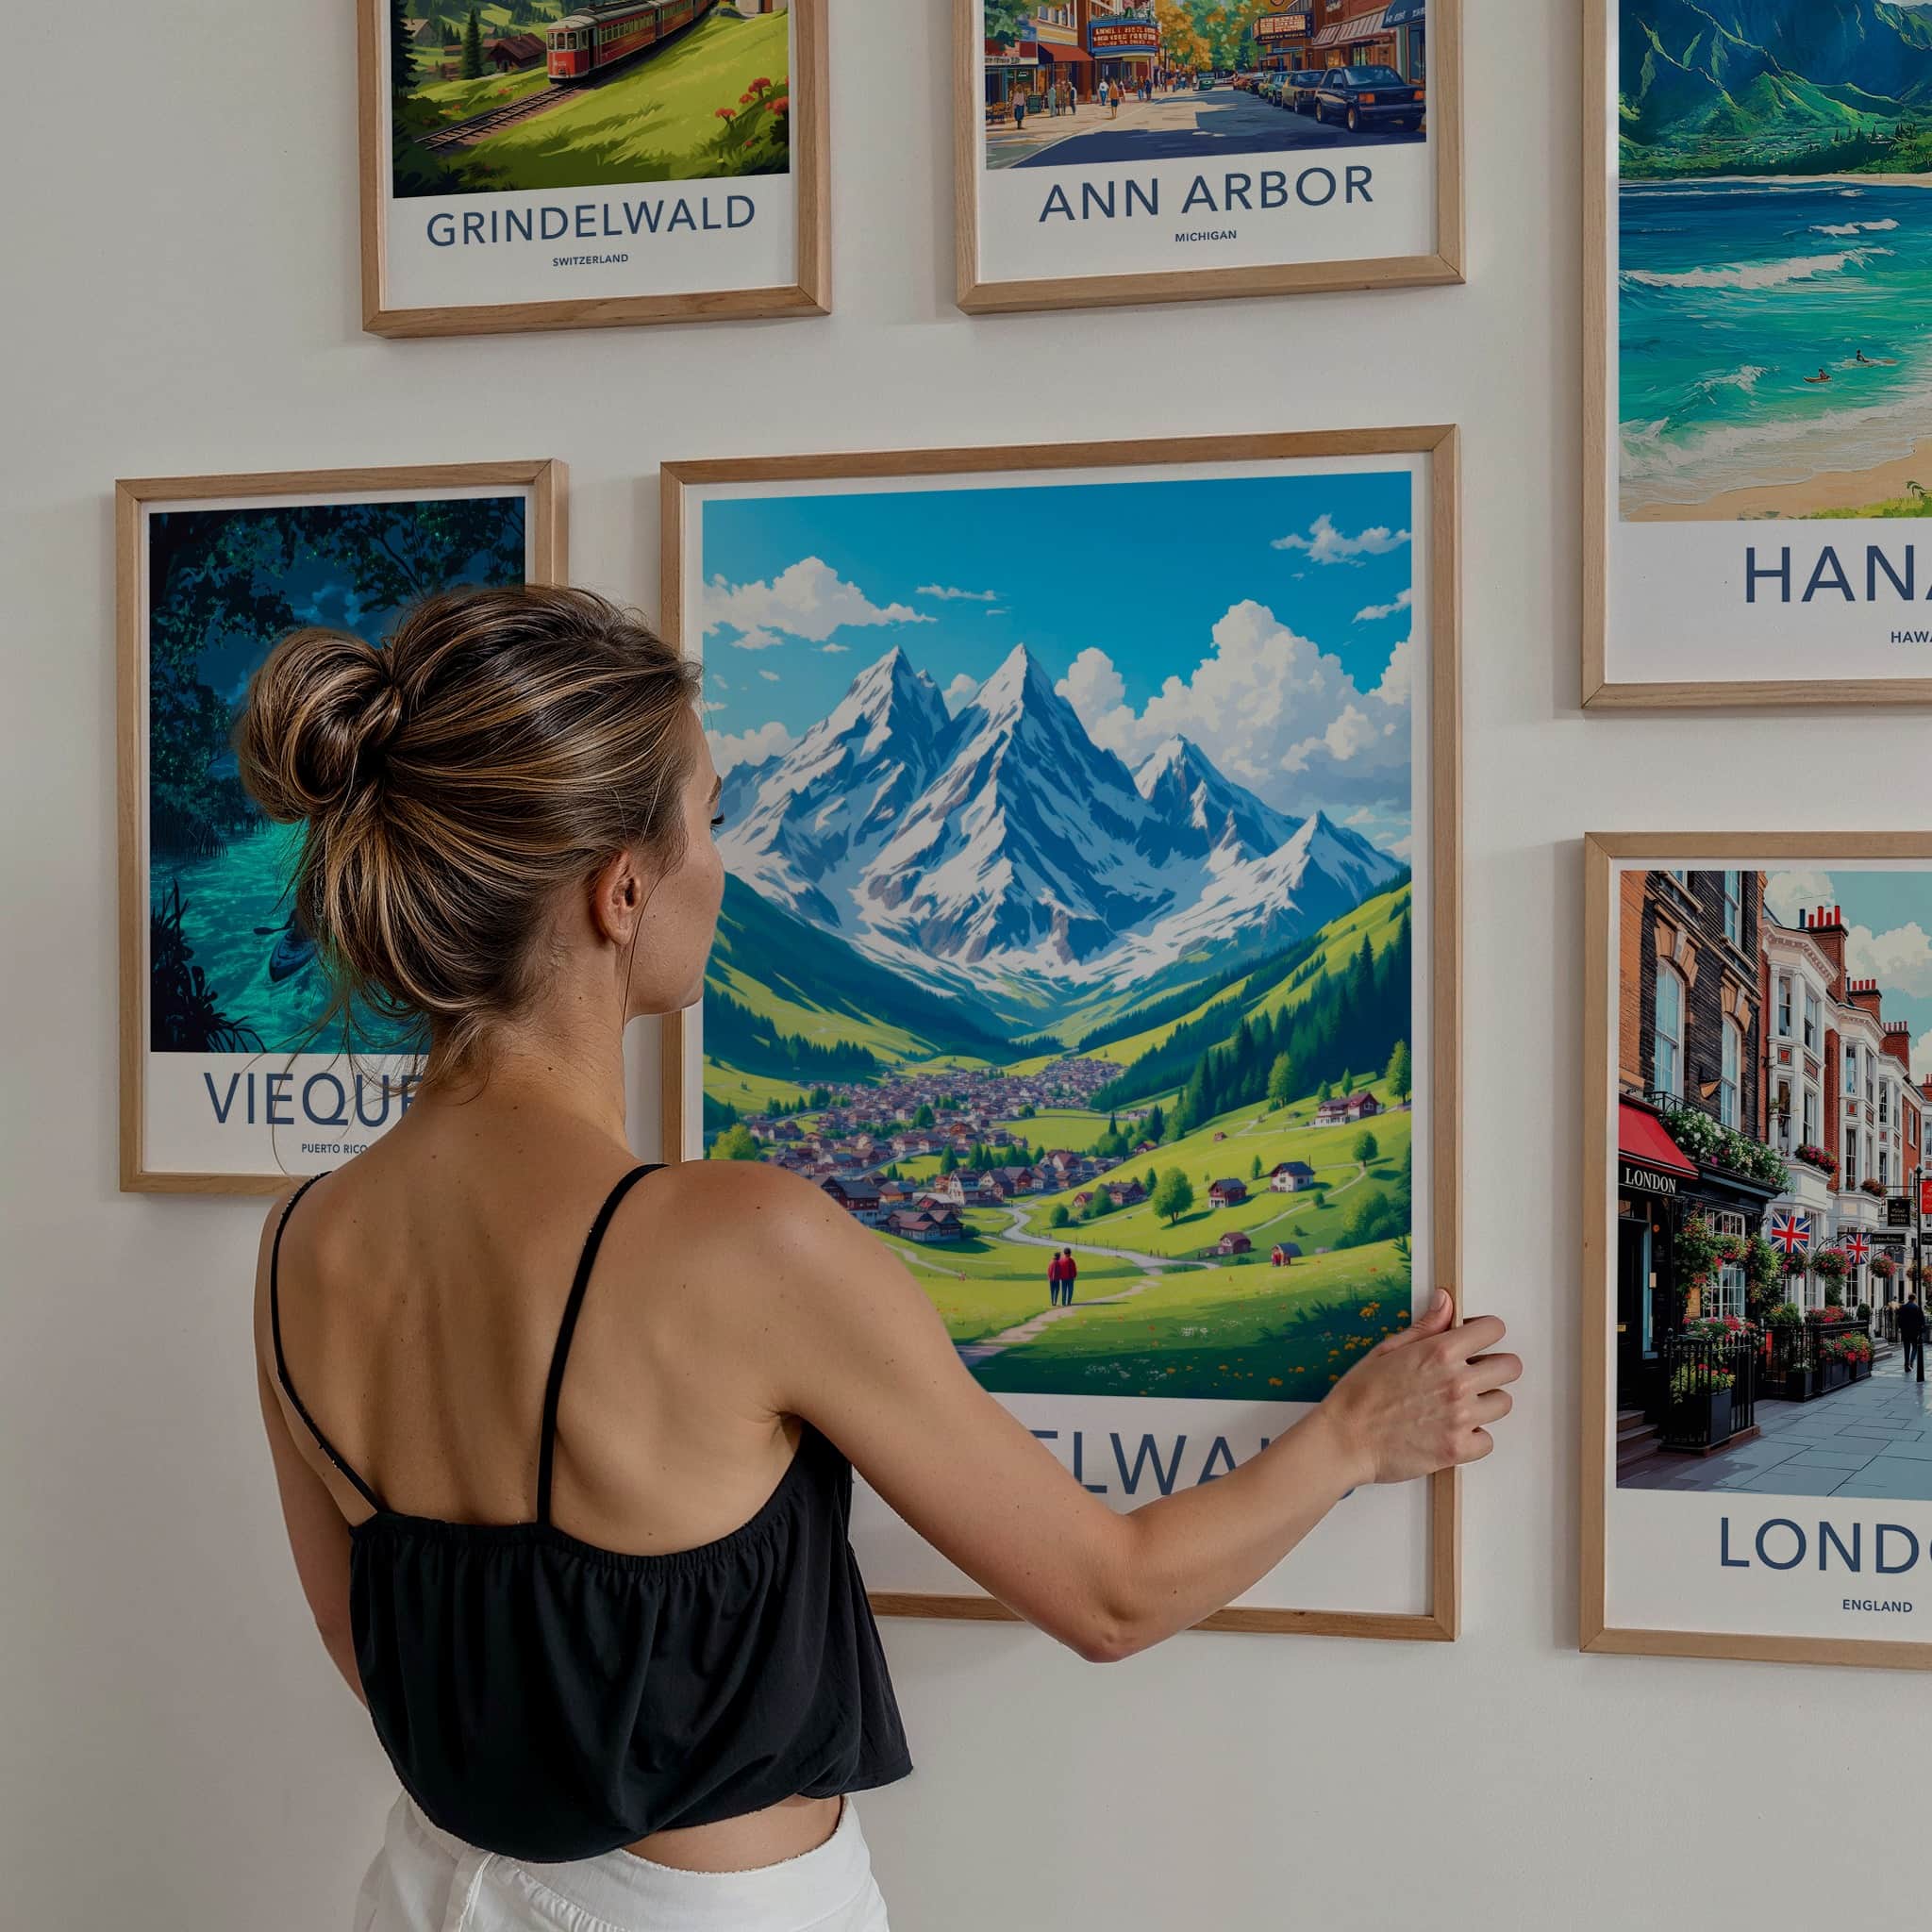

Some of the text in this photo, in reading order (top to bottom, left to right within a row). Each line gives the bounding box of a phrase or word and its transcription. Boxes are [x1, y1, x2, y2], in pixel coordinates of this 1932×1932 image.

[1038, 165, 1374, 223] ANN ARBOR
[426, 194, 756, 247] GRINDELWALD
[1174, 229, 1238, 242] MICHIGAN
[552, 253, 629, 267] SWITZERLAND
[1745, 544, 1932, 604] HAN
[301, 1142, 341, 1154] PUERTO
[1624, 1167, 1676, 1194] LONDON
[1721, 1516, 1932, 1574] LOND
[1841, 1598, 1913, 1614] ENGLAND
